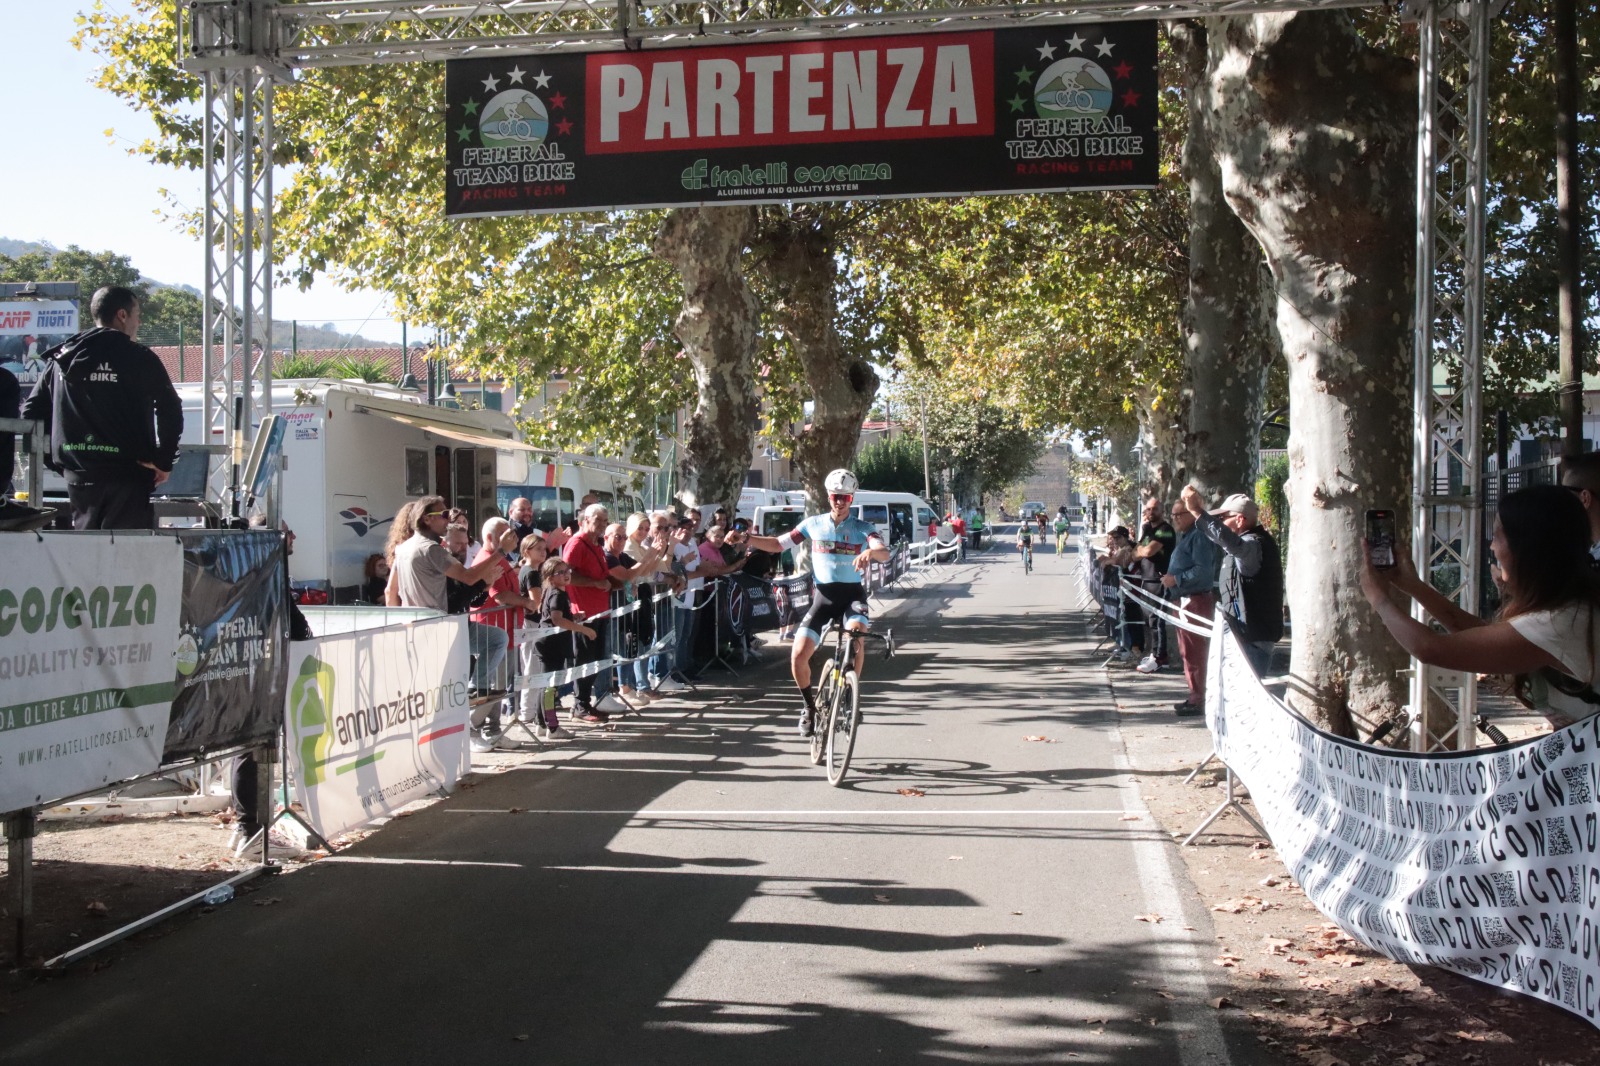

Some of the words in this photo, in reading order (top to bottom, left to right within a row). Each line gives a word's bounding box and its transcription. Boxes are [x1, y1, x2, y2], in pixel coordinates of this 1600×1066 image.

[600, 44, 977, 143] PARTENZA
[1016, 115, 1131, 137] FEDERAL
[463, 142, 565, 166] FEDERAL
[1005, 138, 1079, 159] TEAM
[1085, 136, 1143, 156] BIKE
[453, 164, 518, 186] TEAM
[524, 162, 575, 183] BIKE
[711, 161, 788, 188] fratelli
[794, 163, 892, 184] cosenza
[1016, 161, 1079, 176] RACING
[1089, 159, 1133, 172] TEAM
[462, 186, 517, 201] RACING
[525, 184, 566, 197] TEAM
[717, 187, 765, 197] ALUMINIUM
[767, 186, 784, 195] AND
[787, 185, 823, 194] QUALITY
[825, 183, 859, 192] SYSTEM
[37, 309, 74, 328] NIGHT
[90, 373, 118, 382] BIKE
[0, 583, 157, 637] cosenza
[24, 700, 66, 725] OLTRE
[73, 695, 89, 715] 40
[1419, 761, 1450, 795] ICON
[1481, 818, 1546, 864] ICON
[1439, 873, 1498, 910] ICON
[1381, 906, 1422, 945] ICON
[1429, 916, 1492, 951] ICON
